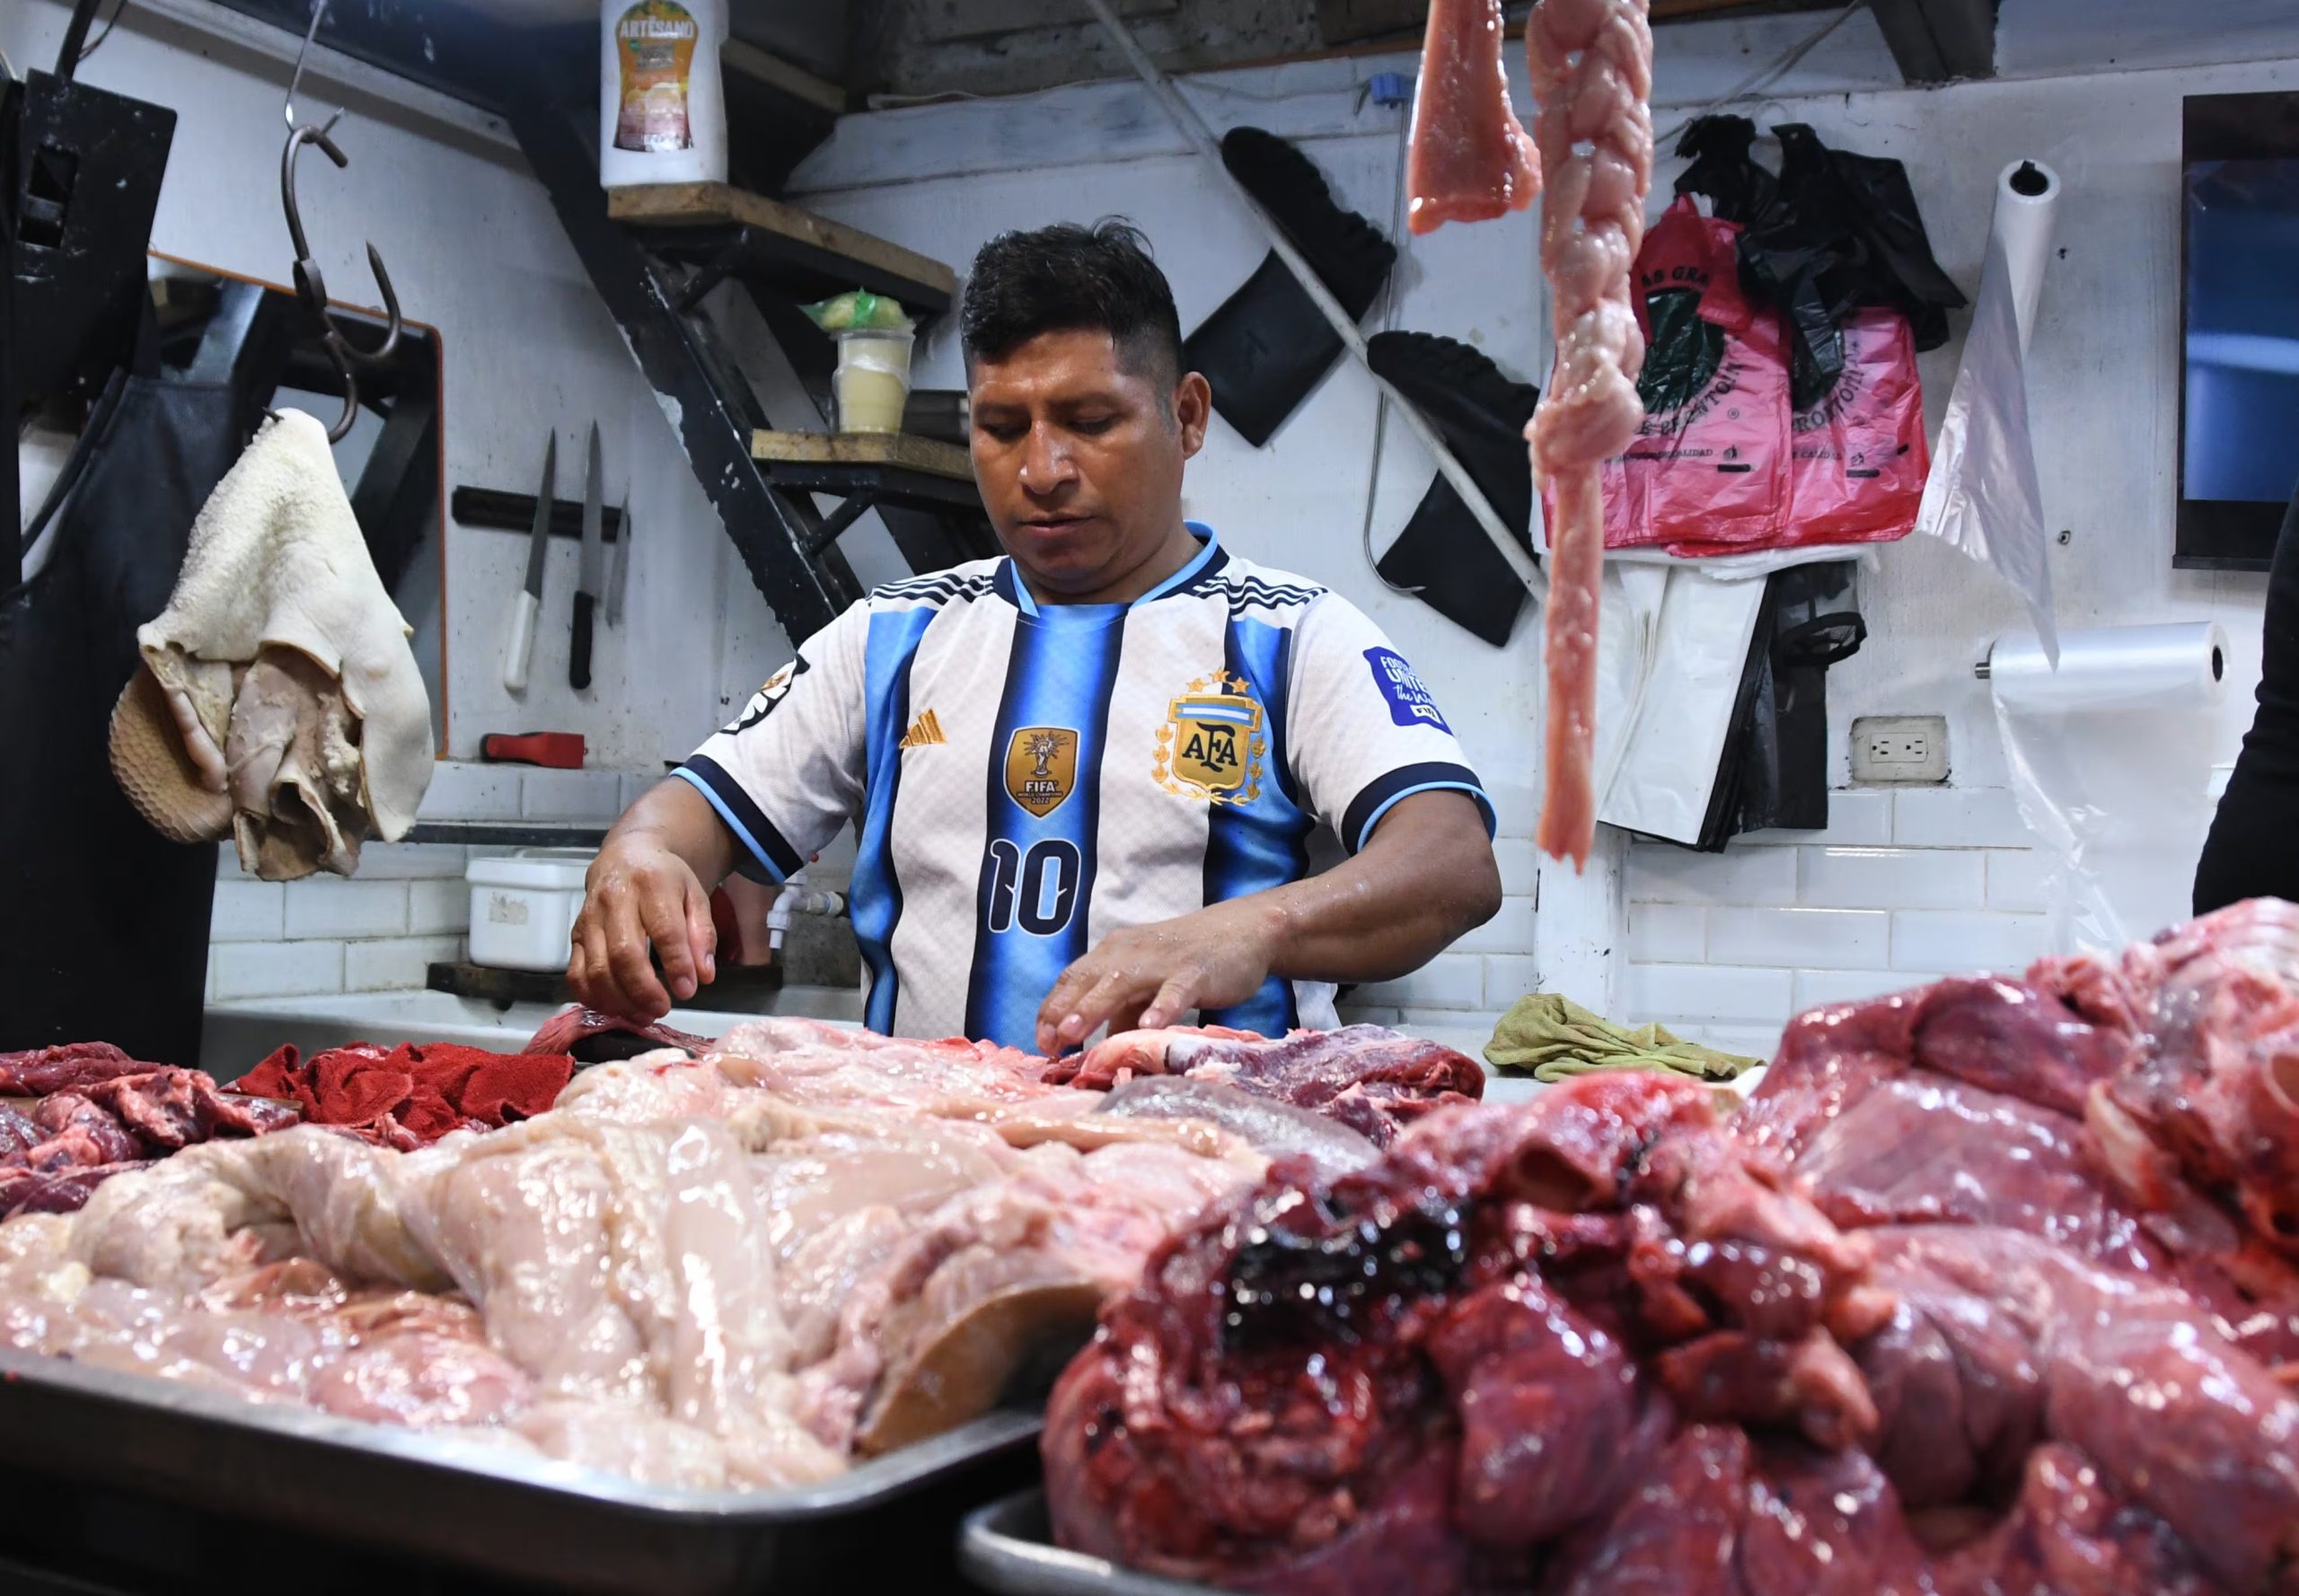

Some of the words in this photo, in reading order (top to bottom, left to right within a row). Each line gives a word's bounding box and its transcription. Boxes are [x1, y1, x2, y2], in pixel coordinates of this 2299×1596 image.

[1182, 721, 1238, 772] AFA
[1026, 780, 1056, 792] FIFA
[1031, 797, 1050, 805] 2022
[988, 838, 1082, 935] 10
